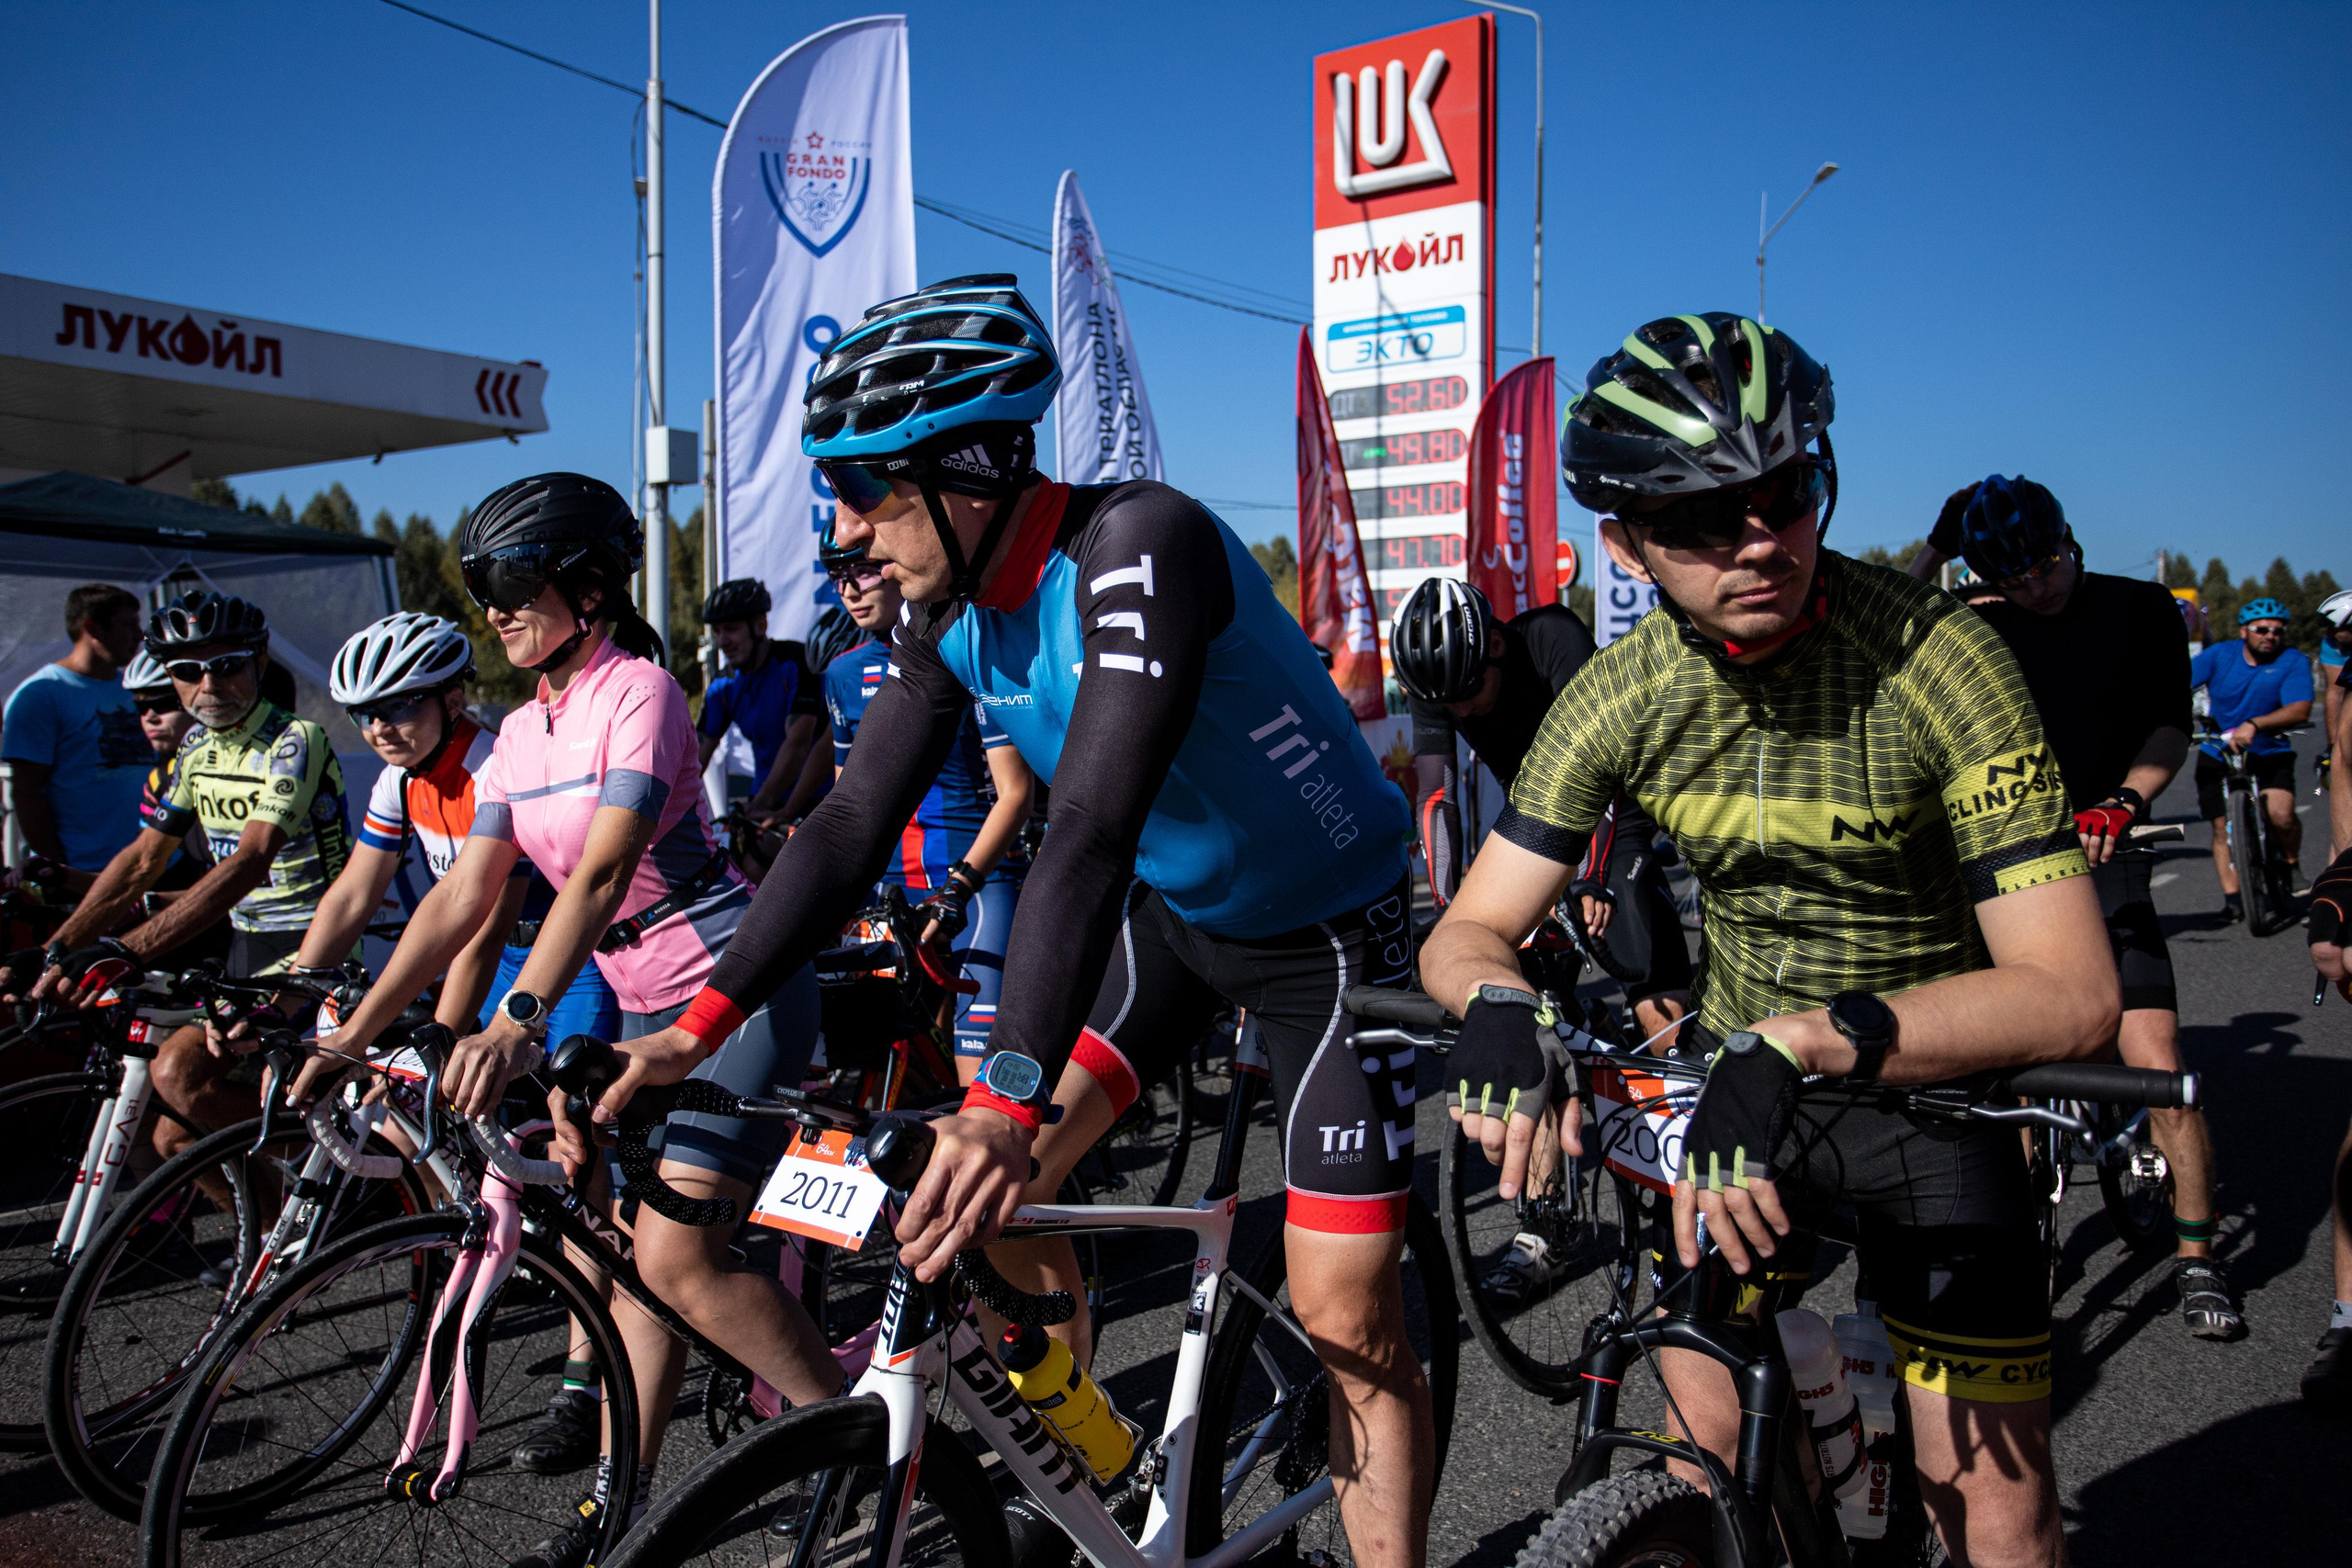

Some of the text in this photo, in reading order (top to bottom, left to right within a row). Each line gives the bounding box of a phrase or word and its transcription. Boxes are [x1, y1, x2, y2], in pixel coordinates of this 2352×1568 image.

[786, 152, 844, 166] GRAN
[787, 166, 846, 180] FONDO
[1329, 231, 1464, 283] ЛУКОЙЛ
[55, 303, 284, 378] ЛУКОЙЛ
[1356, 333, 1434, 364] ЭКТО
[1088, 302, 1118, 470] ТРИАТЛОНА
[1385, 375, 1467, 416] 52.60
[1386, 429, 1467, 466] 49.80
[940, 456, 1001, 479] adidas
[1385, 480, 1467, 516] 44.00
[1498, 433, 1529, 615] acCoffee
[1386, 533, 1467, 568] 47.70
[1089, 555, 1164, 679] Tri
[1249, 704, 1330, 780] Tri
[1300, 773, 1360, 850] atleta
[1830, 808, 1920, 843] NW
[321, 818, 345, 882] Tinko
[653, 902, 672, 916] RUSSIA
[776, 1087, 797, 1098] CYCPLUS
[1318, 1119, 1366, 1152] Tri
[1612, 1116, 1684, 1174] 200
[1321, 1151, 1363, 1166] atleta
[779, 1170, 859, 1219] 2011
[1796, 1382, 1835, 1400] GH5
[951, 1344, 1080, 1495] GIANT
[1004, 1505, 1036, 1521] SCOTT
